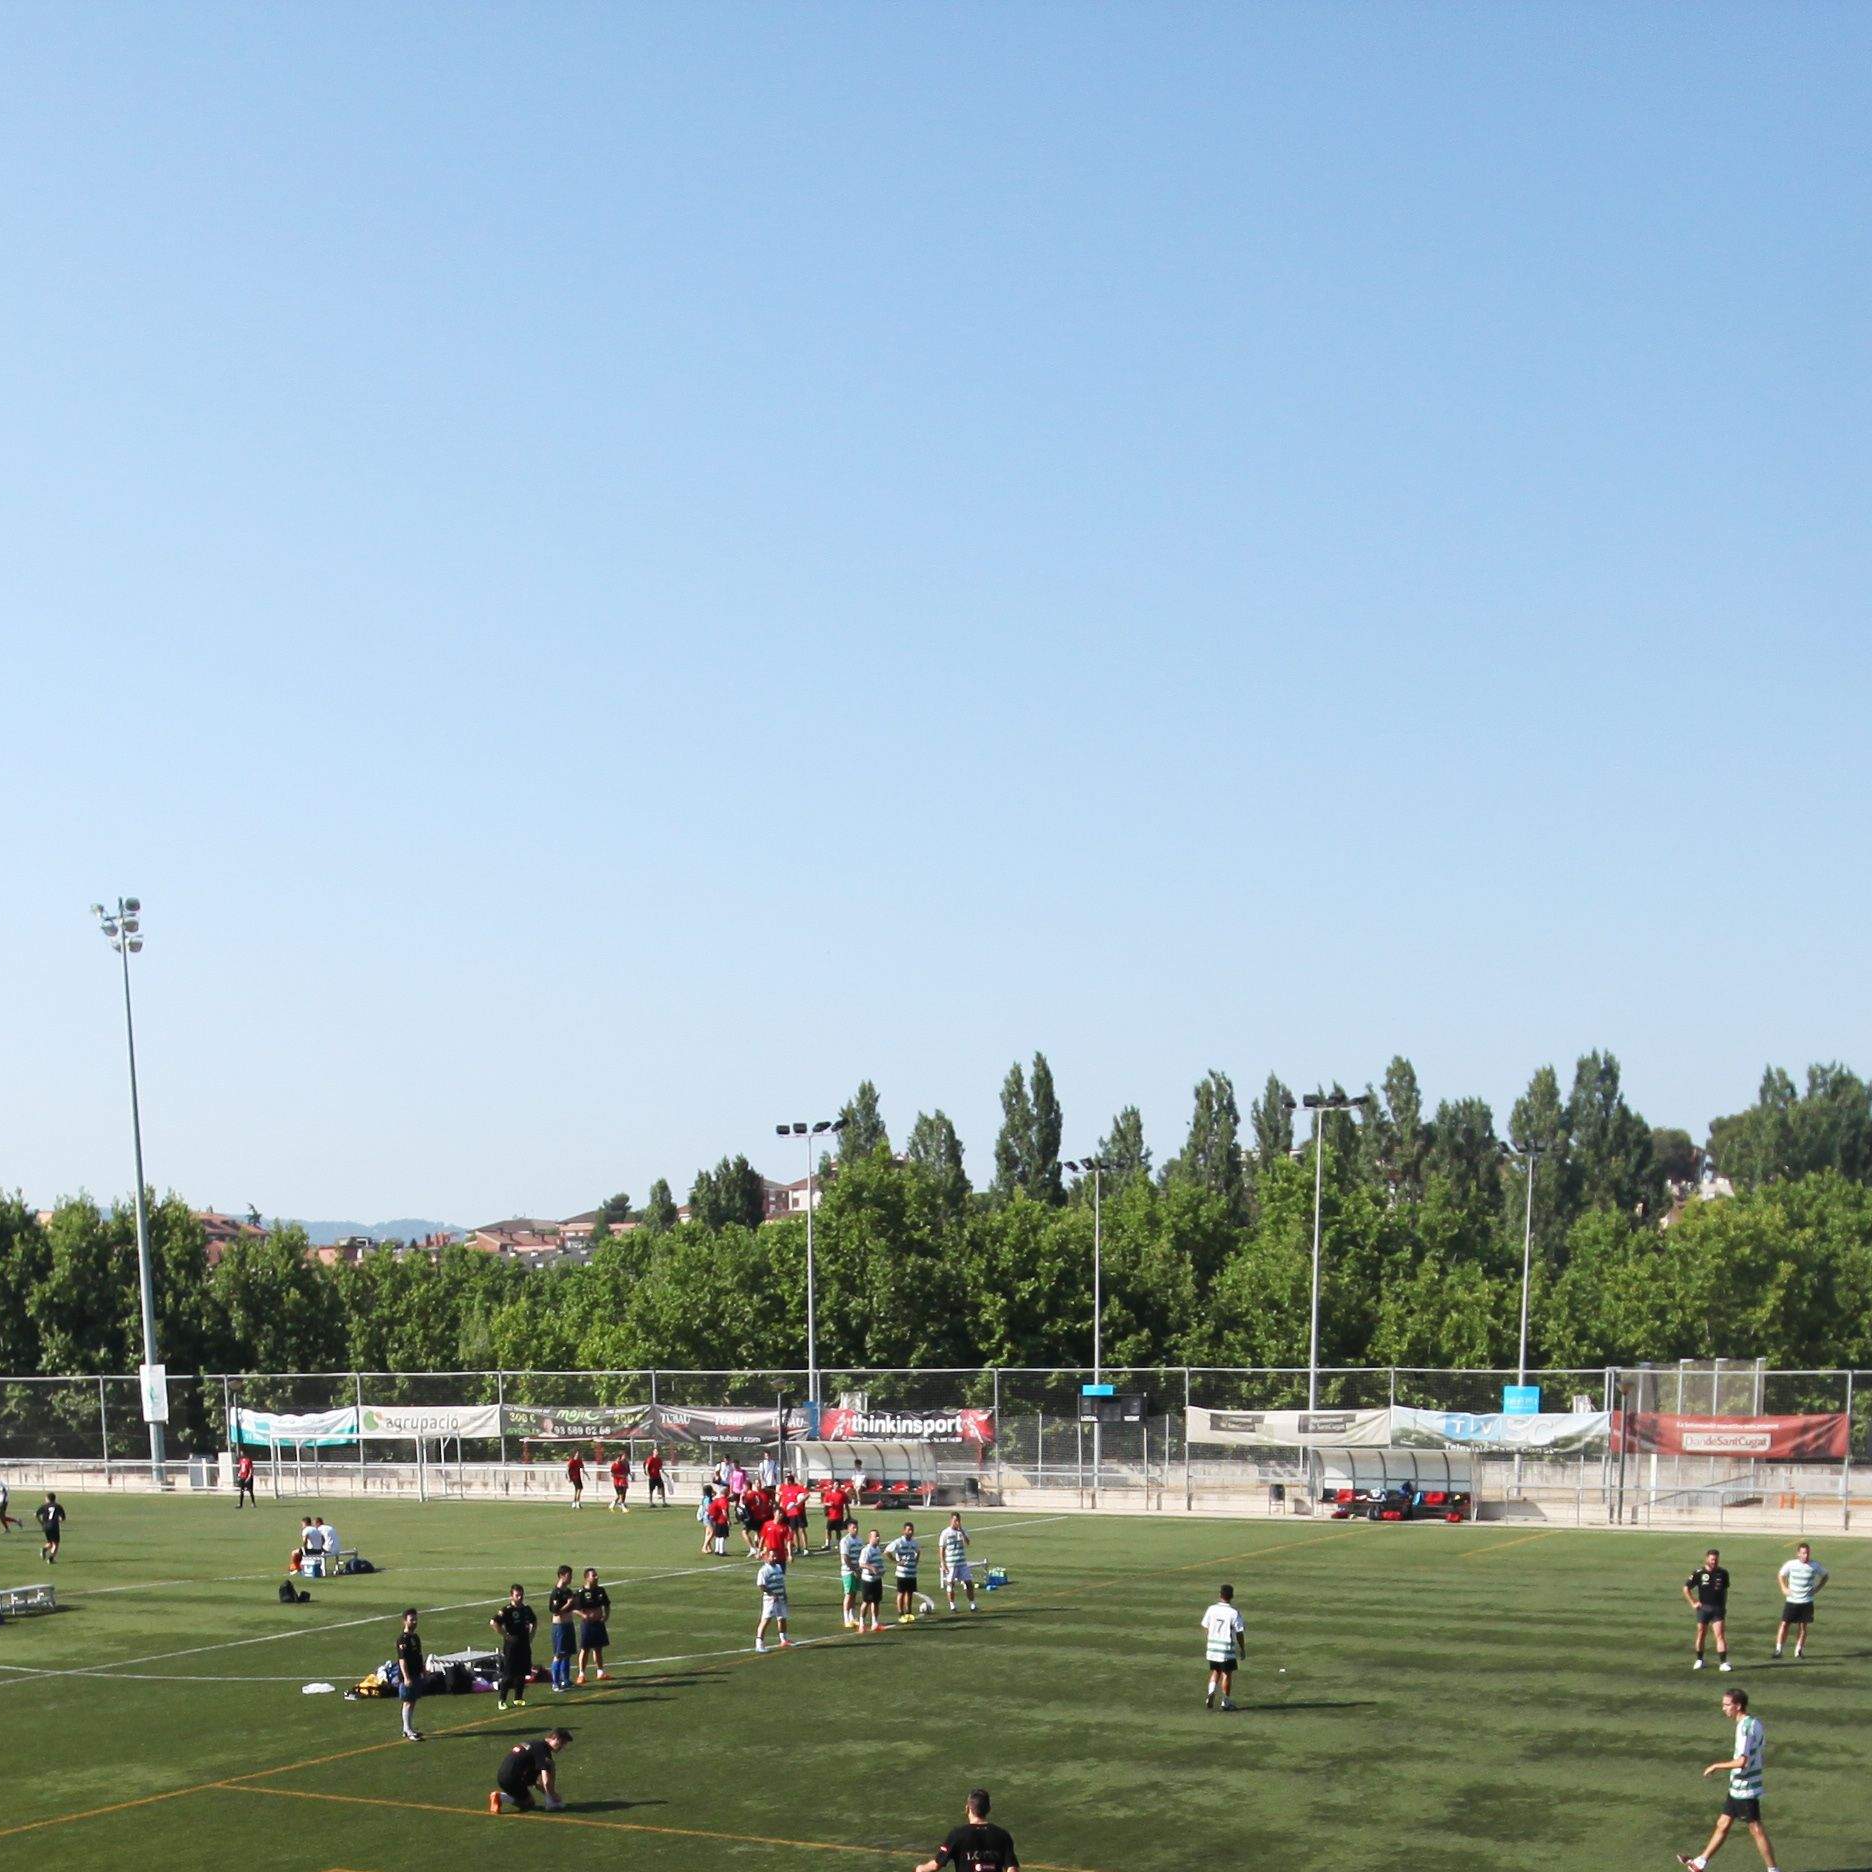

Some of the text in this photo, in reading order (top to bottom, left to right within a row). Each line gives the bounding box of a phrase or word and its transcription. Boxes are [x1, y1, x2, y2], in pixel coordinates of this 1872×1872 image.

[385, 1412, 459, 1433] agrupació
[850, 1412, 964, 1435] thinkinsport
[1215, 1619, 1226, 1633] 7
